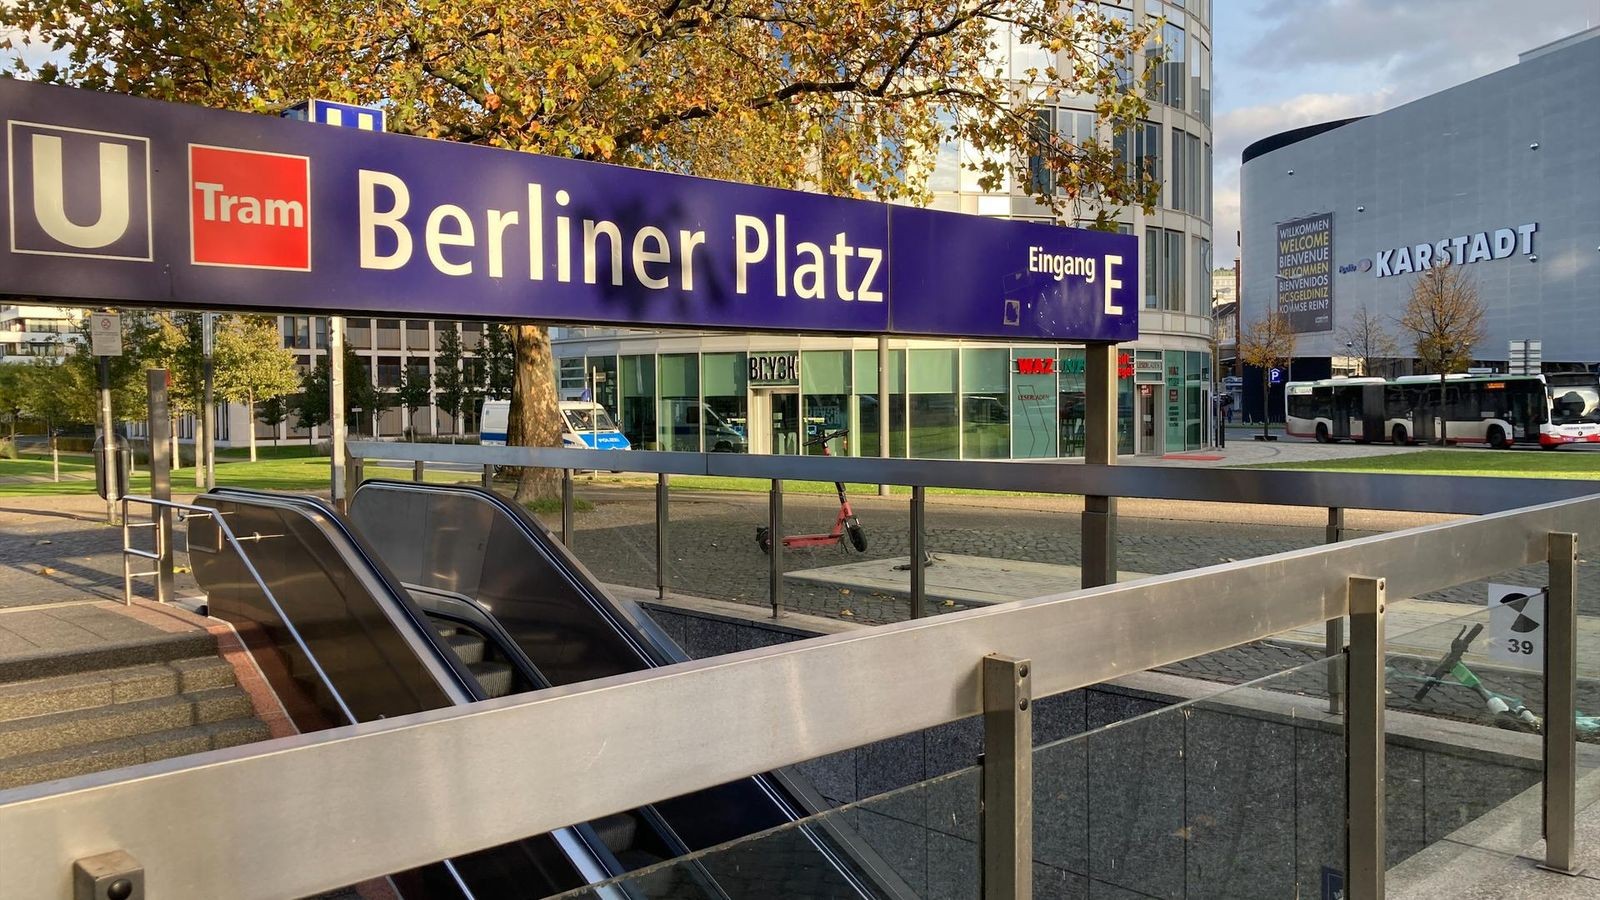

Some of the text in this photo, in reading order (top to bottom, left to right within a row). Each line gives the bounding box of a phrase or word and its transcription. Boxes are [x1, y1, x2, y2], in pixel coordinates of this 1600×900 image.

[31, 133, 130, 249] U
[194, 182, 304, 228] Tram
[358, 169, 884, 303] Berliner Platz
[1280, 219, 1329, 239] WILLKOMMEN
[1280, 231, 1329, 254] WELCOME
[1376, 222, 1538, 278] KARSTADT
[1280, 247, 1329, 268] BIENVENUE
[1029, 246, 1123, 316] Eingang E
[1280, 274, 1329, 292] BIENVENIDOS
[1017, 357, 1055, 375] WAZ
[1507, 638, 1534, 655] 39
